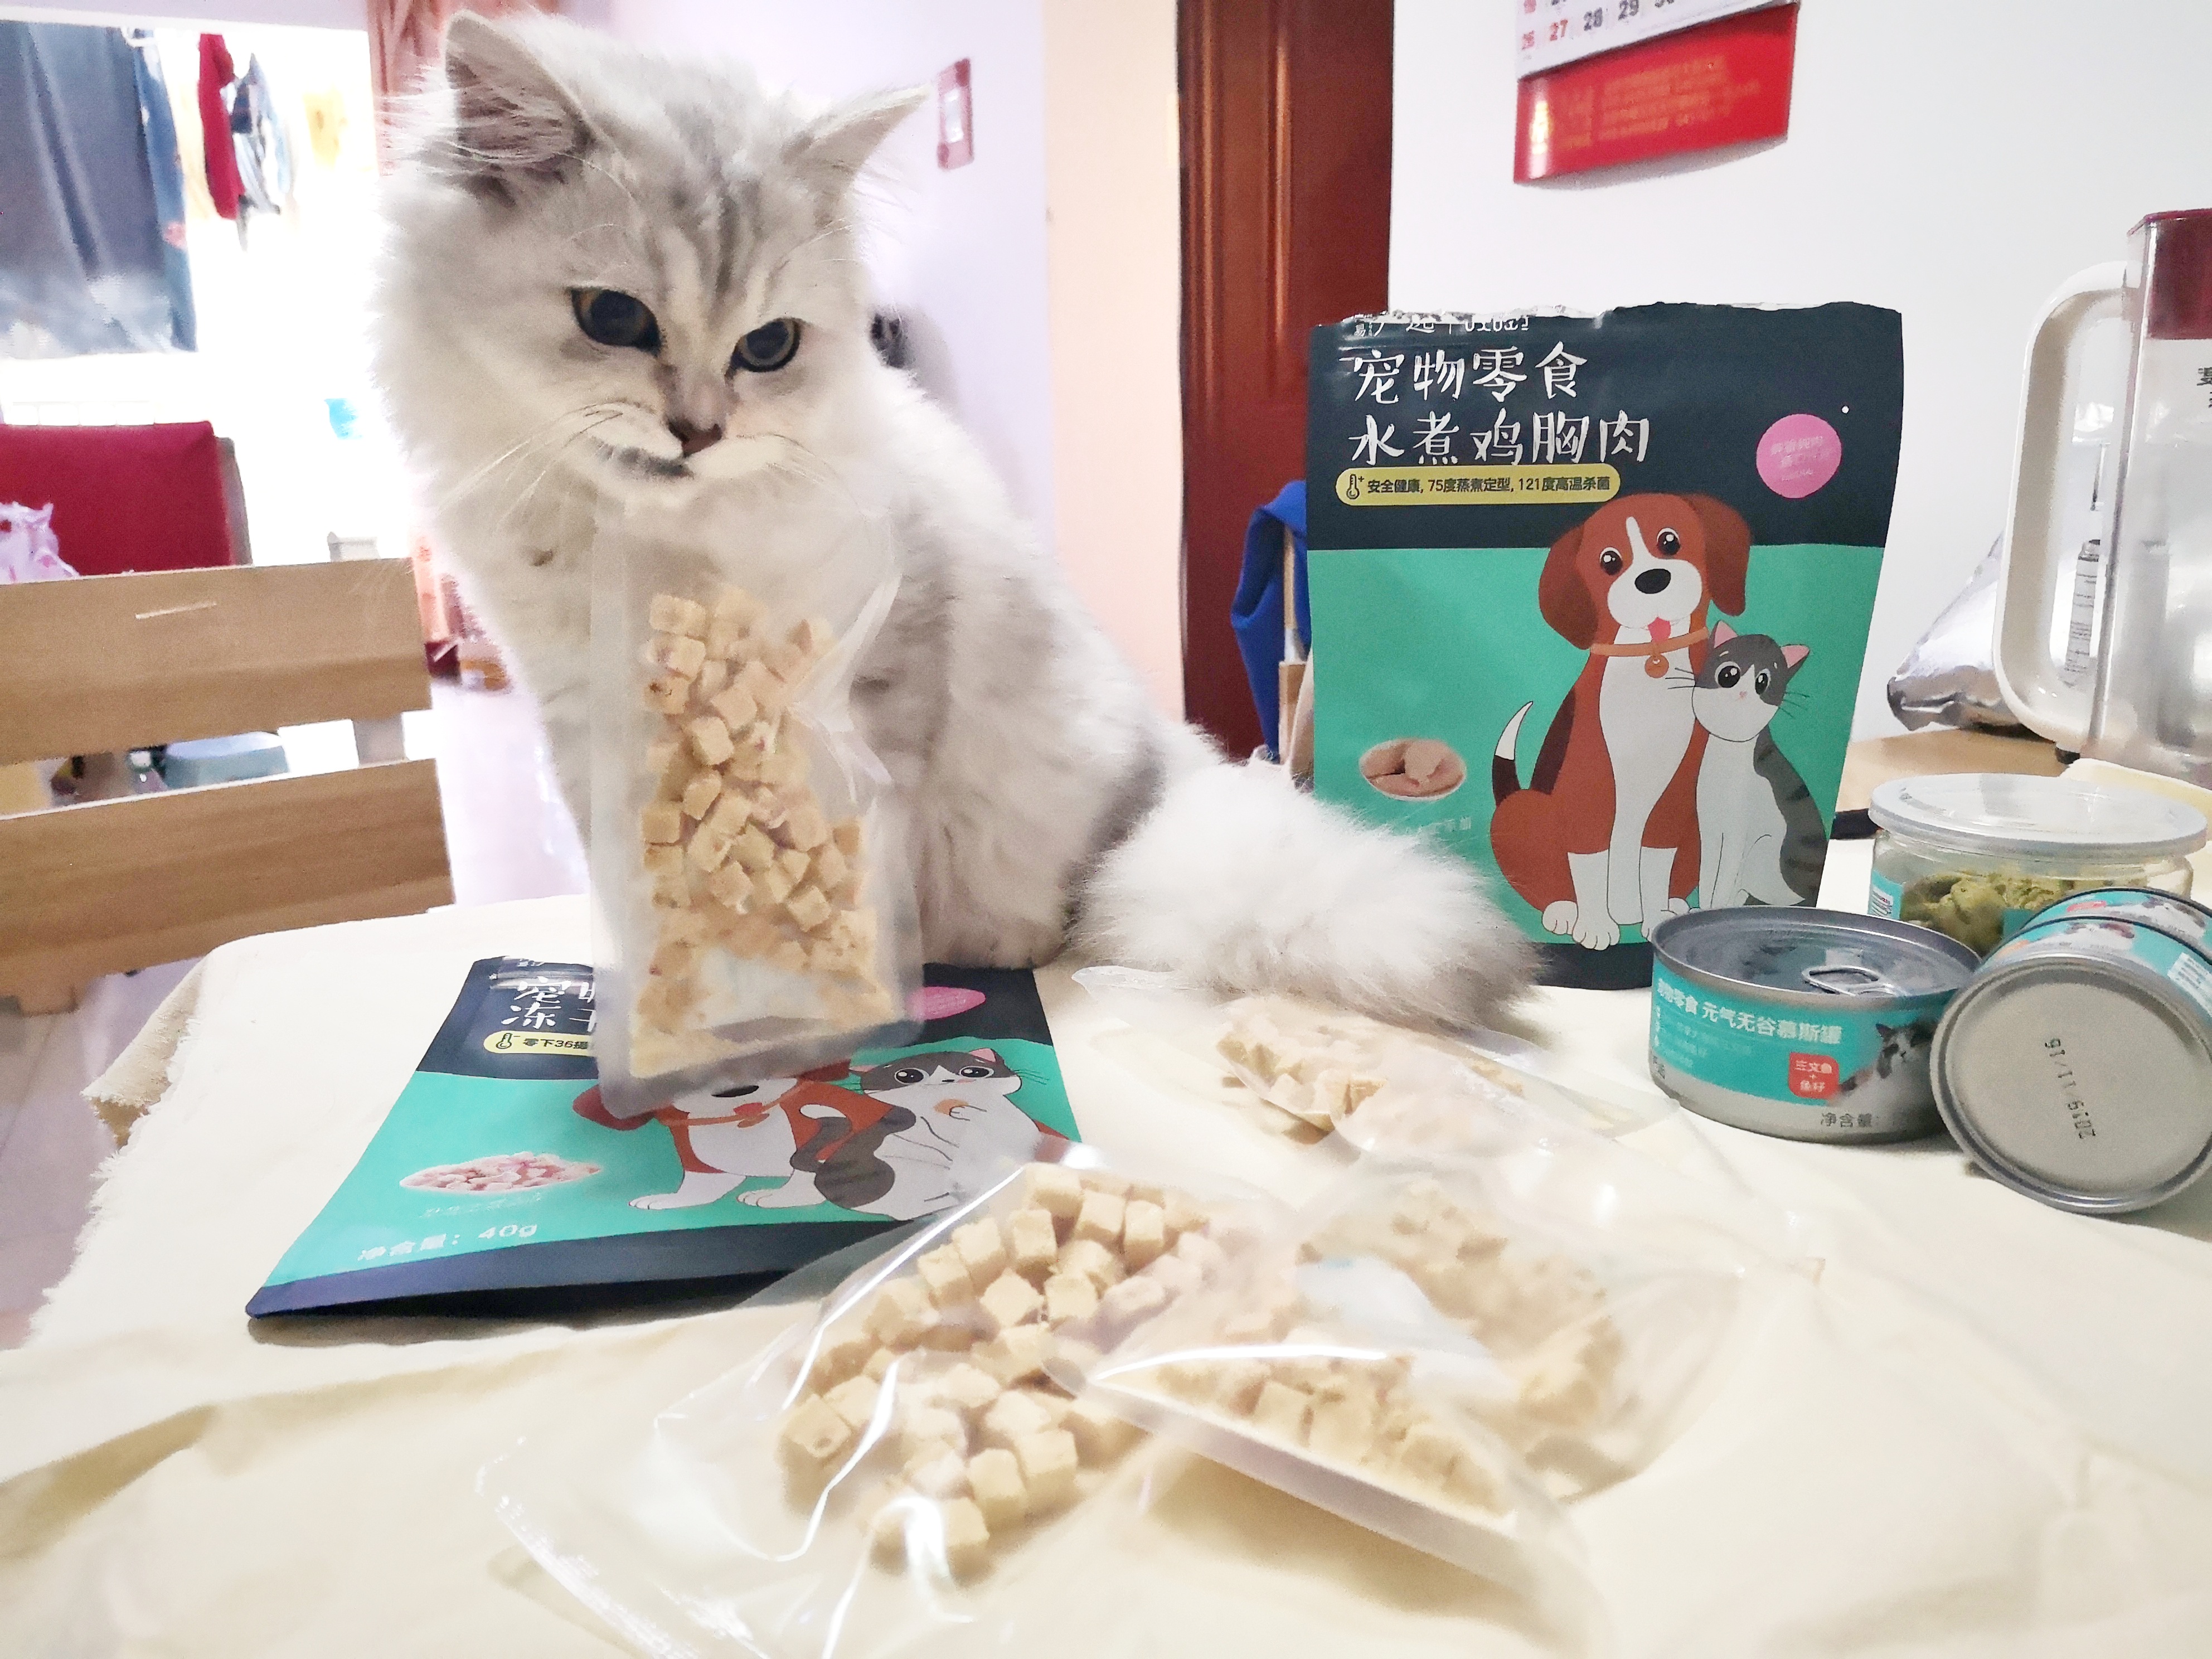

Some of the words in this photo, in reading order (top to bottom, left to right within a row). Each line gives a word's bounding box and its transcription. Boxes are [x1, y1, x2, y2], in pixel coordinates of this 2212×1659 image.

[1550, 18, 1569, 41] 27
[1353, 341, 1588, 404] 宠物零食
[1348, 408, 1650, 465] 水煮鸡胸肉
